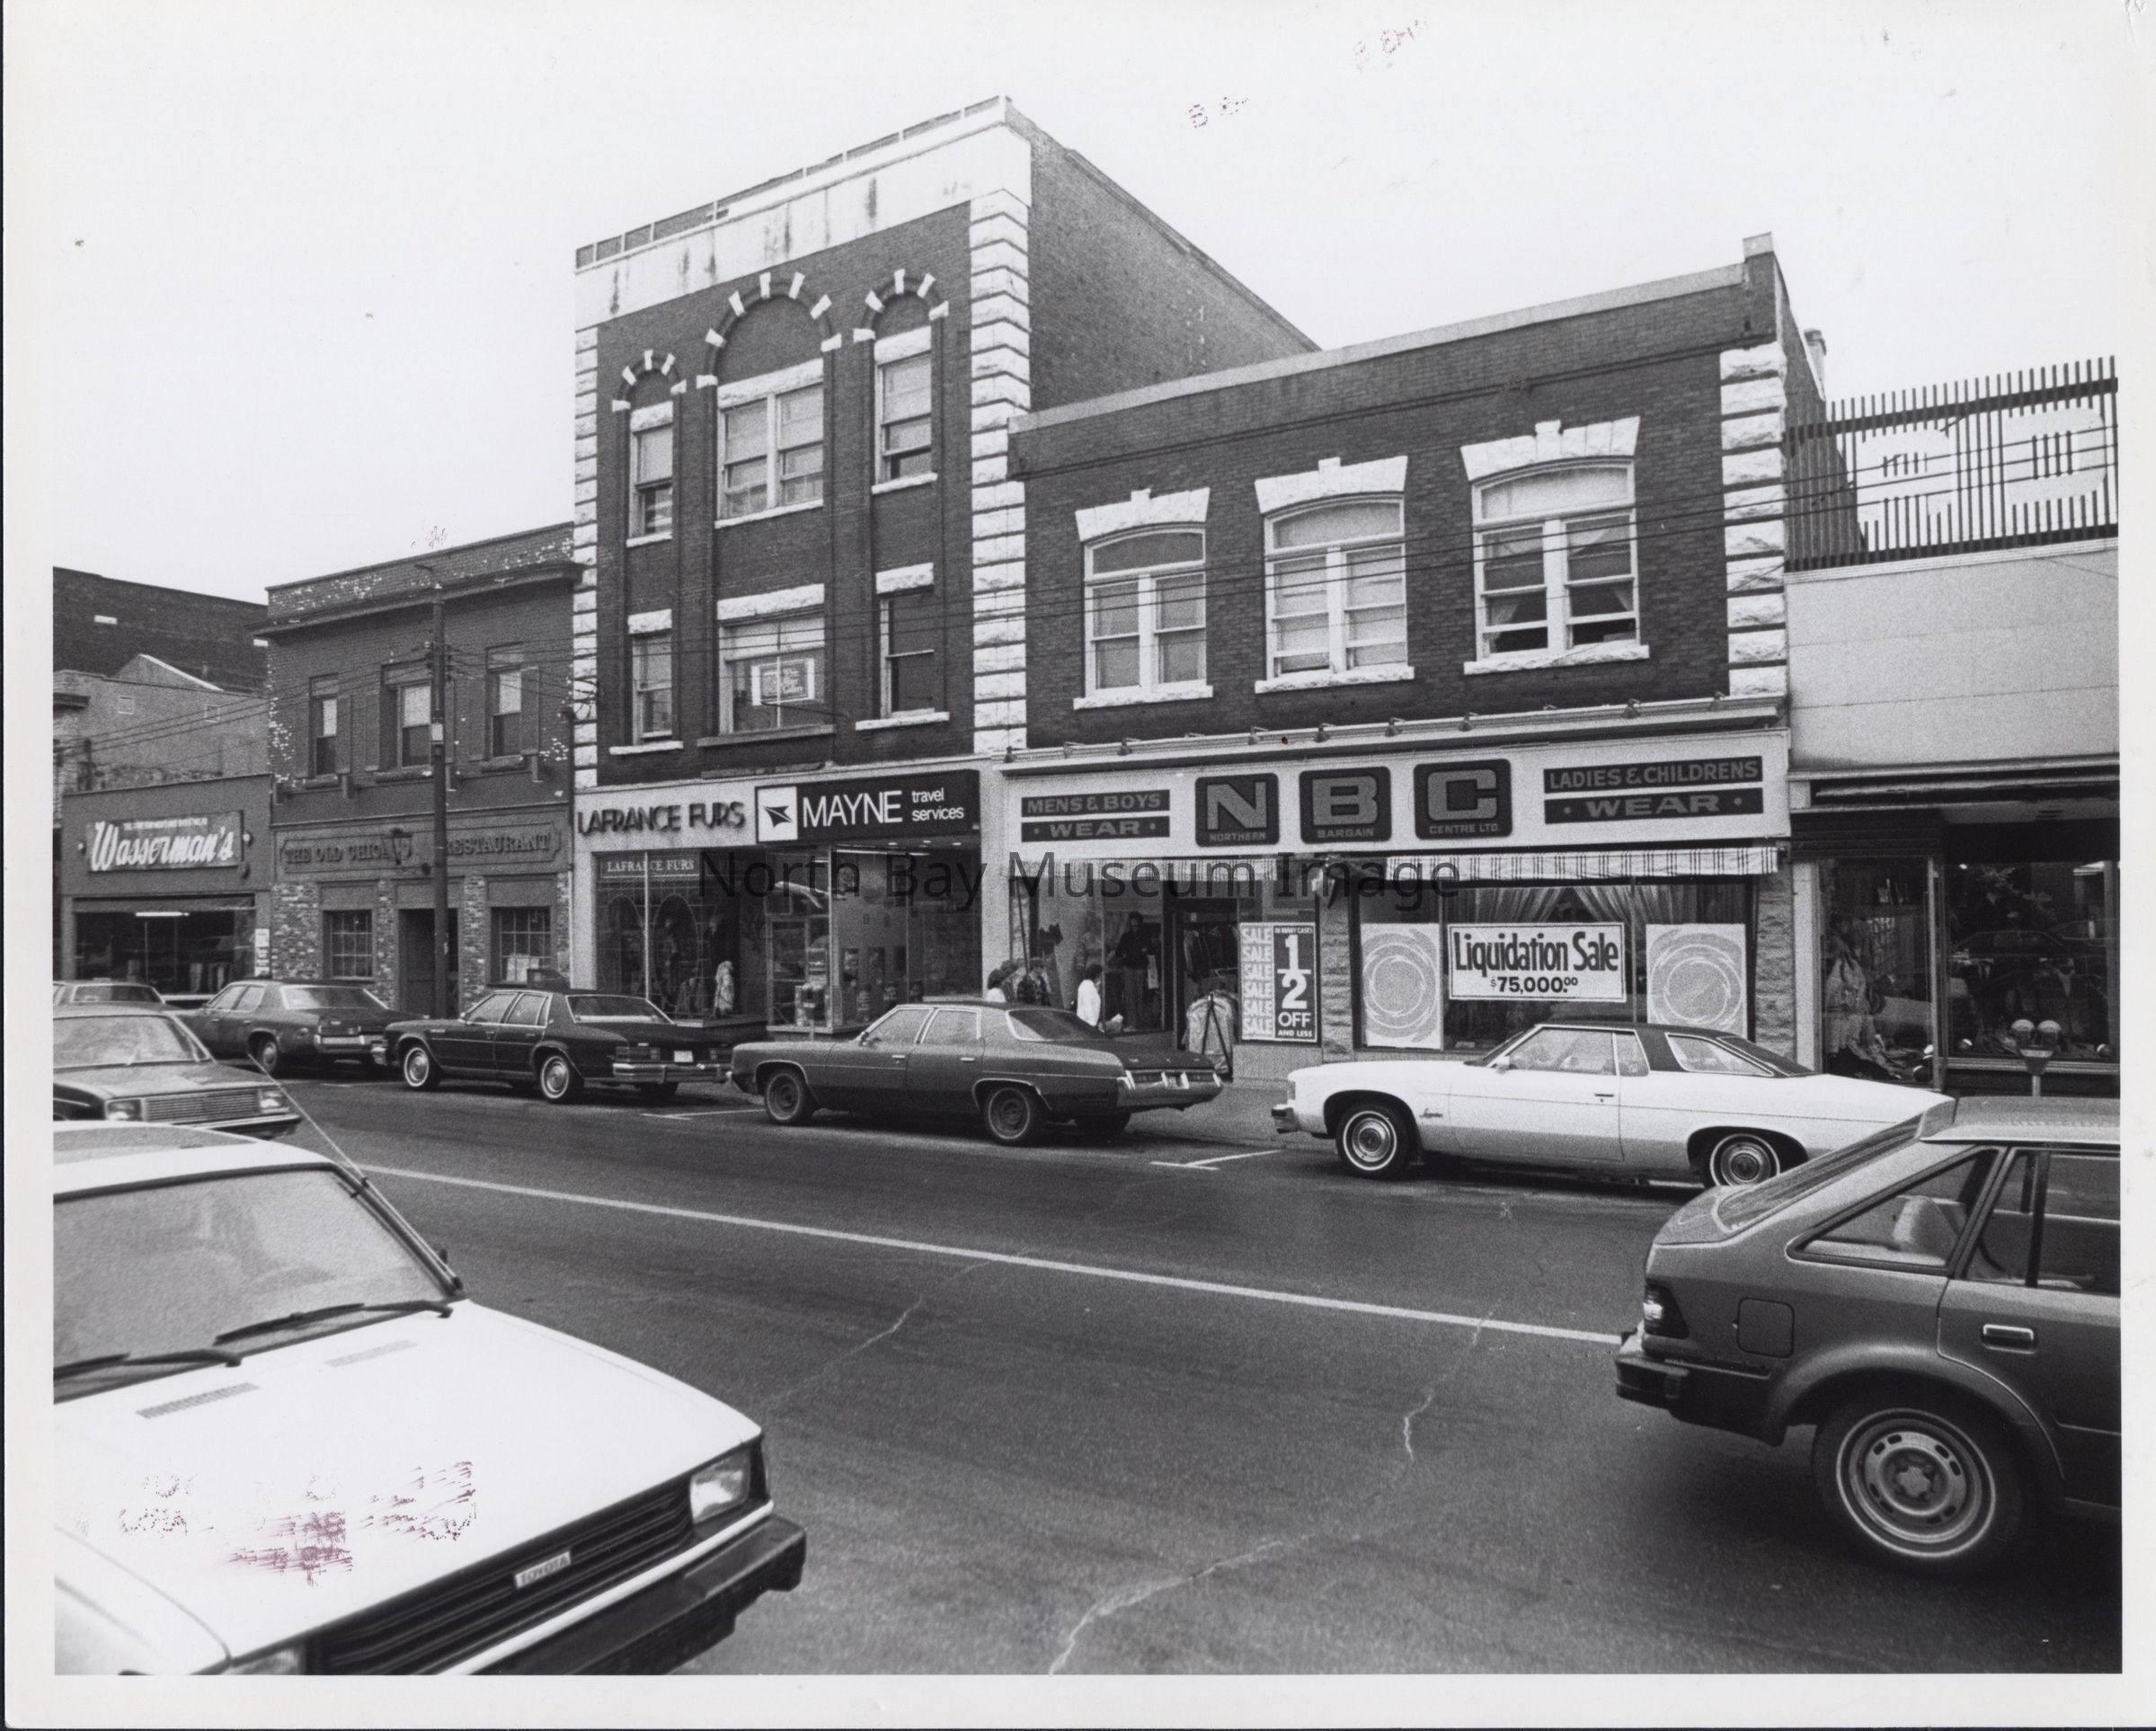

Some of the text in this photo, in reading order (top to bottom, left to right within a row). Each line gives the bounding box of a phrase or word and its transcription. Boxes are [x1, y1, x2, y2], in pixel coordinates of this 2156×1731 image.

[1550, 760, 1759, 790] LADIES & CHILDRENS
[911, 787, 945, 803] travel
[1027, 793, 1161, 814] MENS & BOYS
[1207, 769, 1497, 831] N B C
[803, 790, 903, 829] MAYNE
[911, 806, 964, 822] services
[1585, 794, 1720, 818] WEAR
[578, 801, 746, 837] LAFRANCE FURS
[1429, 823, 1476, 835] CENTRE
[1050, 821, 1140, 839] WEAR
[1210, 831, 1266, 843] NORTHERN
[1317, 828, 1374, 839] BARGAIN
[91, 820, 235, 872] Wasserman's
[284, 847, 312, 864] THE
[315, 846, 343, 863] OLD
[348, 840, 413, 861] CHICA
[667, 859, 695, 871] FURS
[1453, 931, 1619, 978] Liquidation Sale
[1277, 1011, 1311, 1027] OFF
[1277, 1029, 1313, 1037] AND LESS
[520, 1555, 569, 1585] TOYOTA
